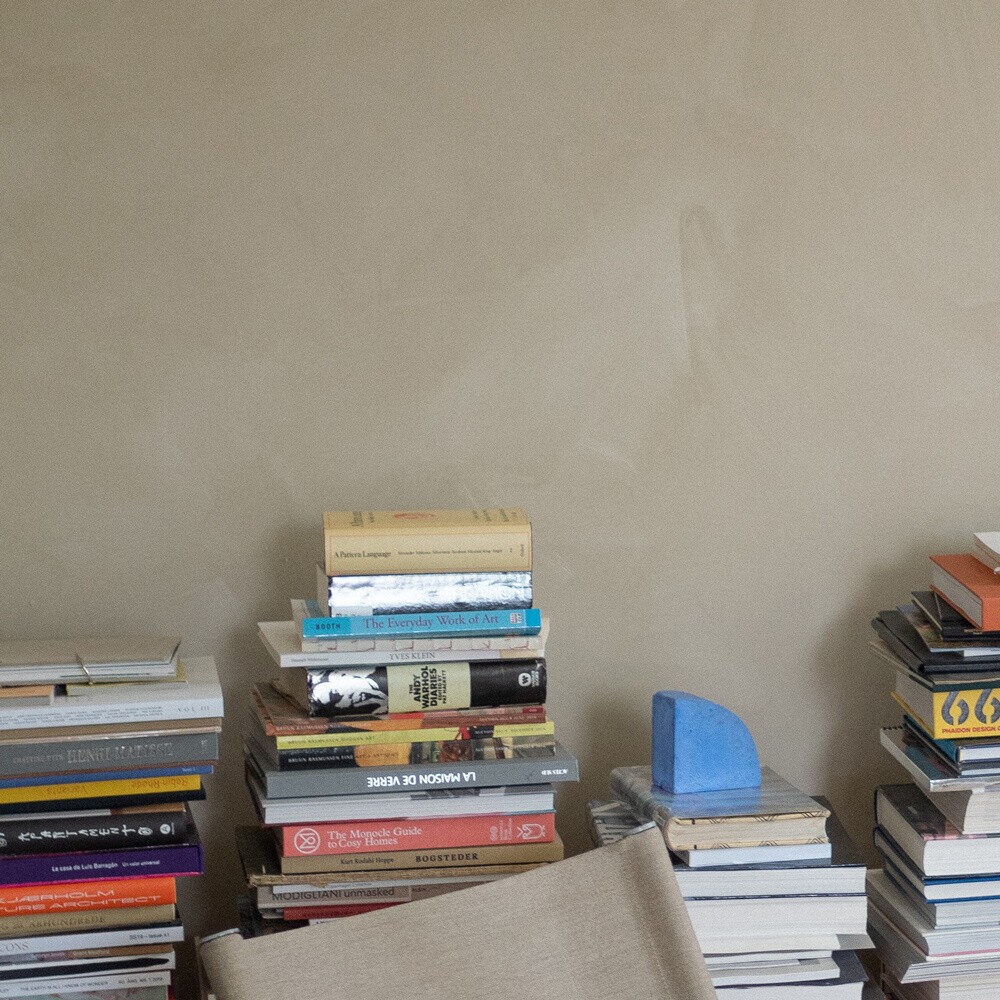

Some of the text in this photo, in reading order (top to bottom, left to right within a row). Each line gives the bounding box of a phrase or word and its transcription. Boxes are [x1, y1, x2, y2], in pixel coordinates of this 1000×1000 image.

[340, 551, 362, 559] Pattern
[362, 550, 392, 559] Language
[315, 623, 341, 631] BOOTH
[364, 613, 499, 630] The Everyday Work of Art
[389, 651, 436, 660] YVES KLEIN
[413, 674, 421, 703] ANDY
[421, 665, 429, 709] WARHOL
[429, 667, 438, 707] DIARIES
[941, 726, 972, 734] PHAIDON
[67, 746, 111, 764] HENRI
[366, 771, 477, 788] LA MAISON DE VERRE
[327, 825, 423, 841] The Monocle Guide
[327, 836, 399, 849] to Cosy Homes
[415, 852, 479, 863] BOGSTEDER
[81, 863, 93, 871] Luis
[271, 887, 395, 901] MODIGLIANI unmasked
[50, 895, 162, 909] ARCHITECT
